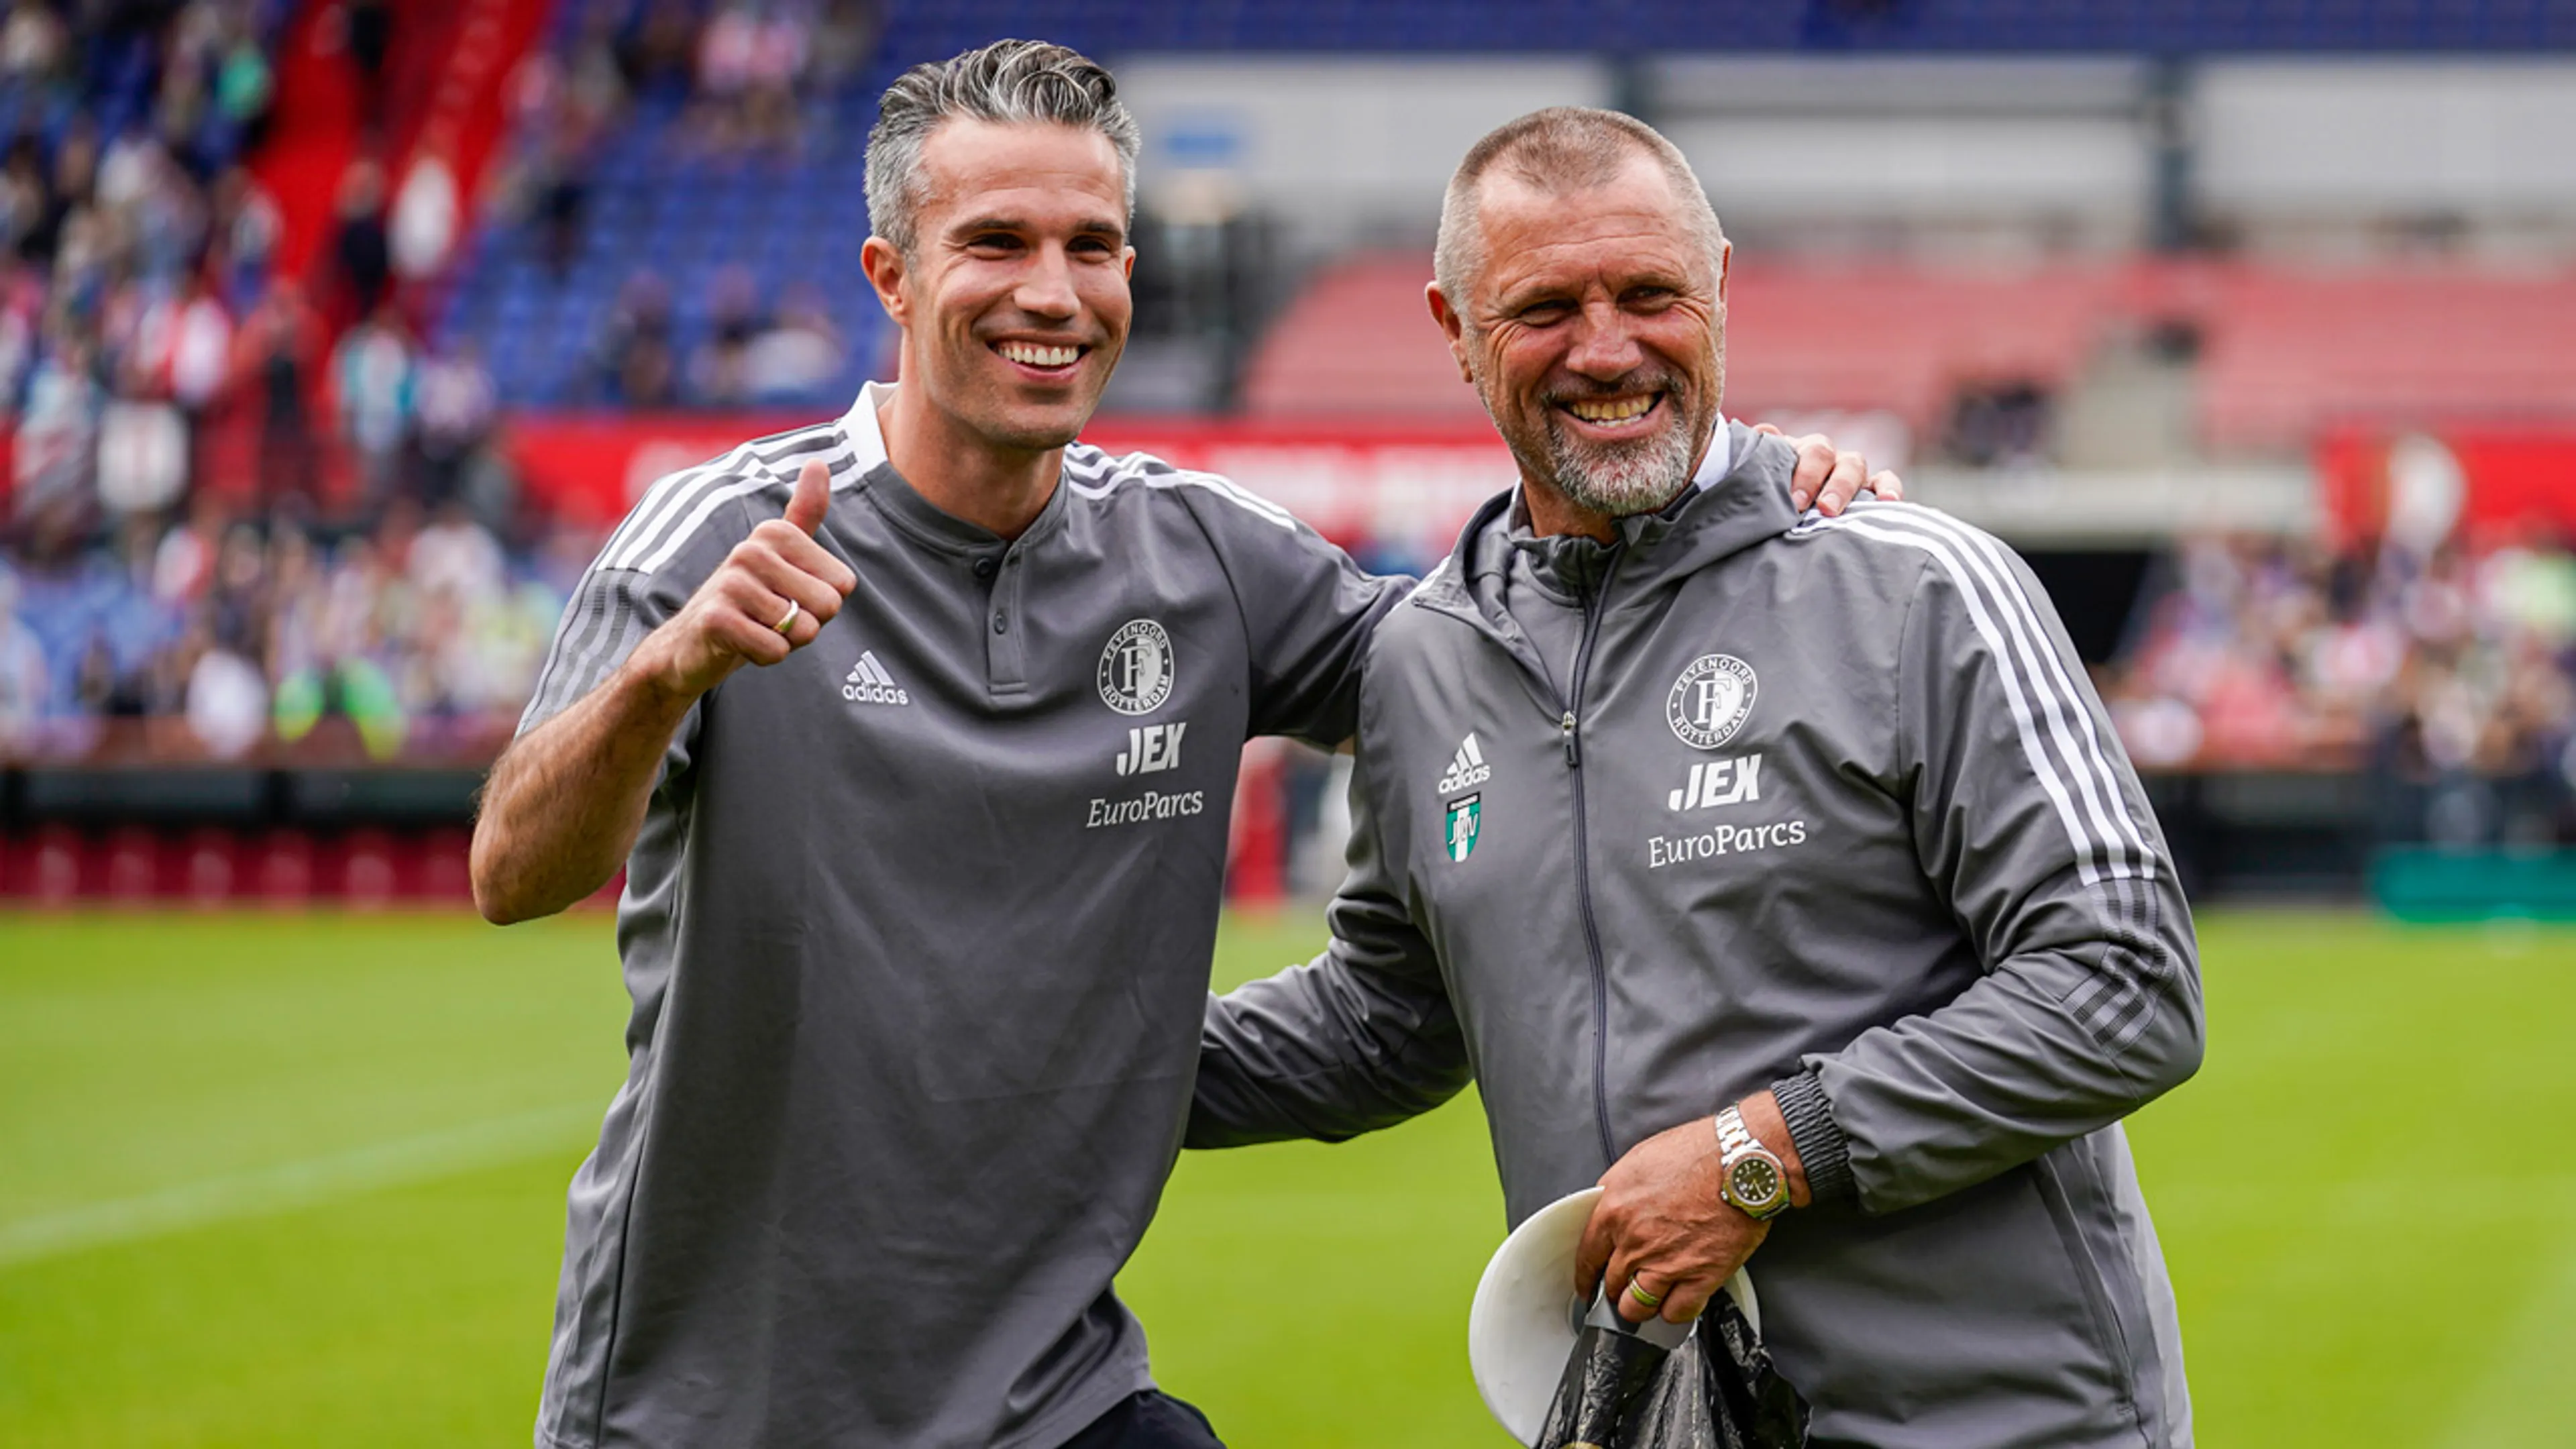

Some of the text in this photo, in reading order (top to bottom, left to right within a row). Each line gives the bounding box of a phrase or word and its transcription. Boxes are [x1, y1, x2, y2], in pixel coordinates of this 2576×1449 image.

[843, 682, 908, 705] adidas
[1103, 674, 1170, 712] ROTTERDAM
[1116, 722, 1187, 777] JEX
[1438, 765, 1491, 794] adidas
[1668, 753, 1762, 812] JEX
[1085, 790, 1203, 828] EuroParcs
[1648, 820, 1807, 868] EuroParcs
